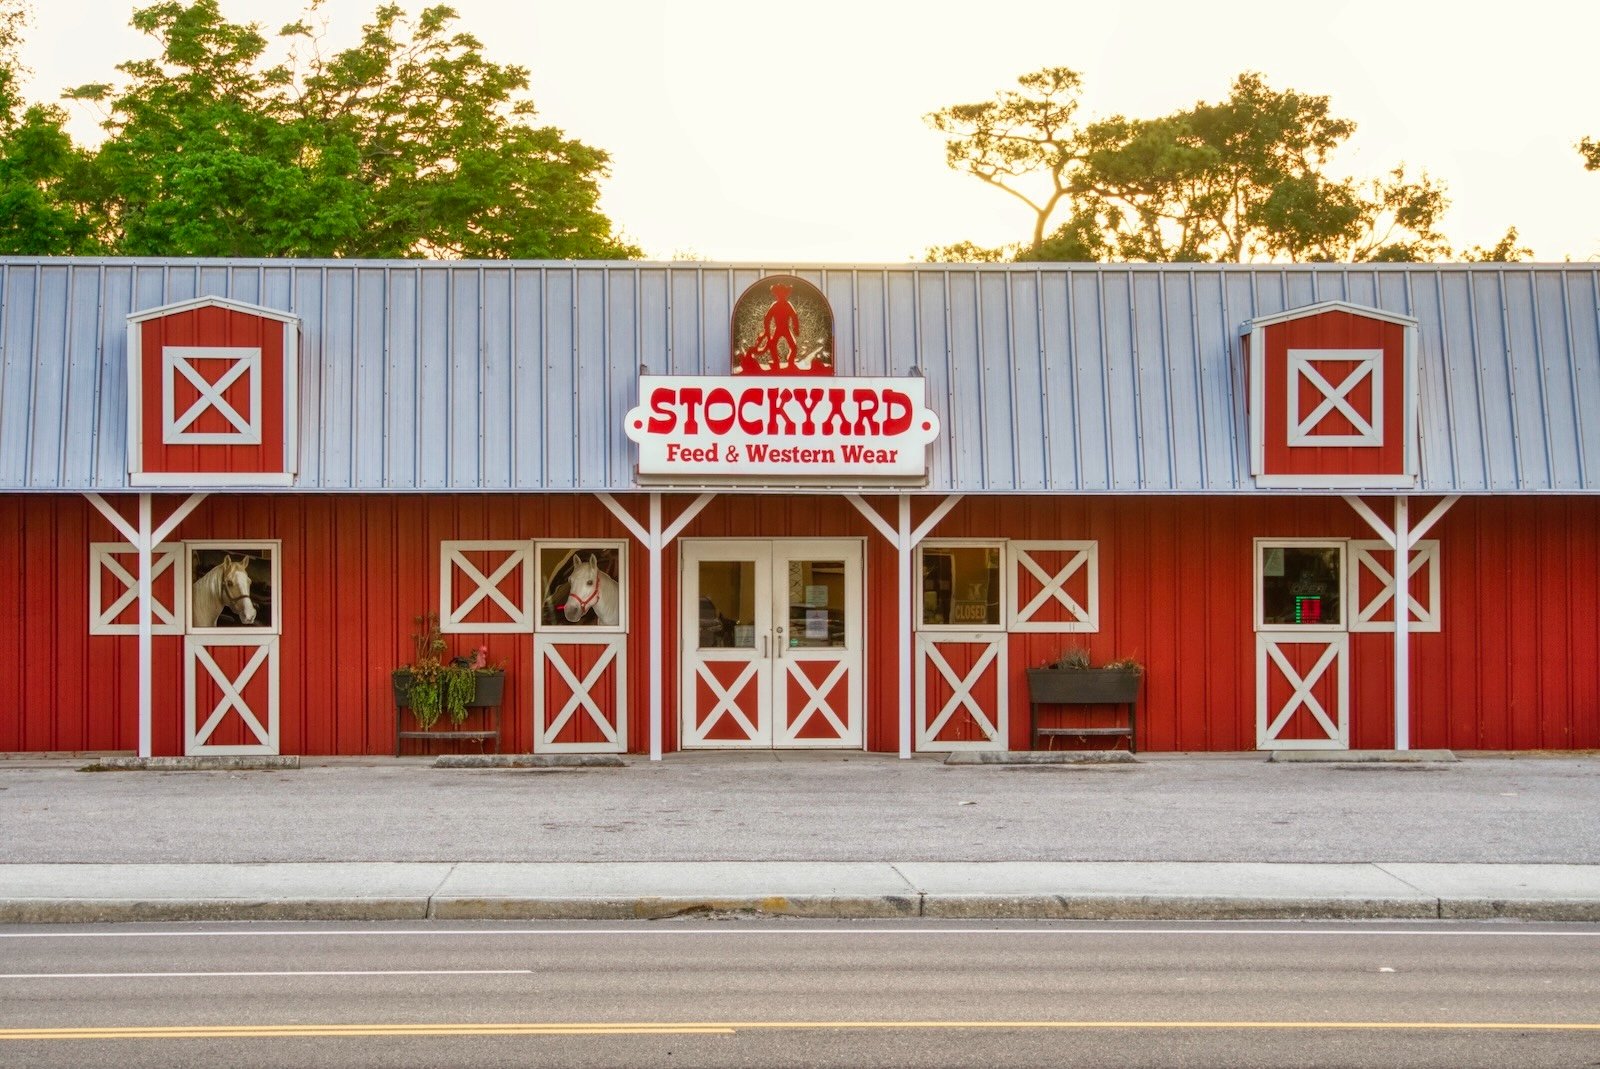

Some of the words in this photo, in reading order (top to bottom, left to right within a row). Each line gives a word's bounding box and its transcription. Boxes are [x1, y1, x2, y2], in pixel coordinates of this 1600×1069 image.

[647, 387, 913, 436] STOCKYARD
[667, 443, 719, 463] Feed
[725, 445, 740, 463] &
[745, 444, 836, 464] Western
[841, 445, 899, 464] Wear
[955, 604, 986, 619] CLOSED
